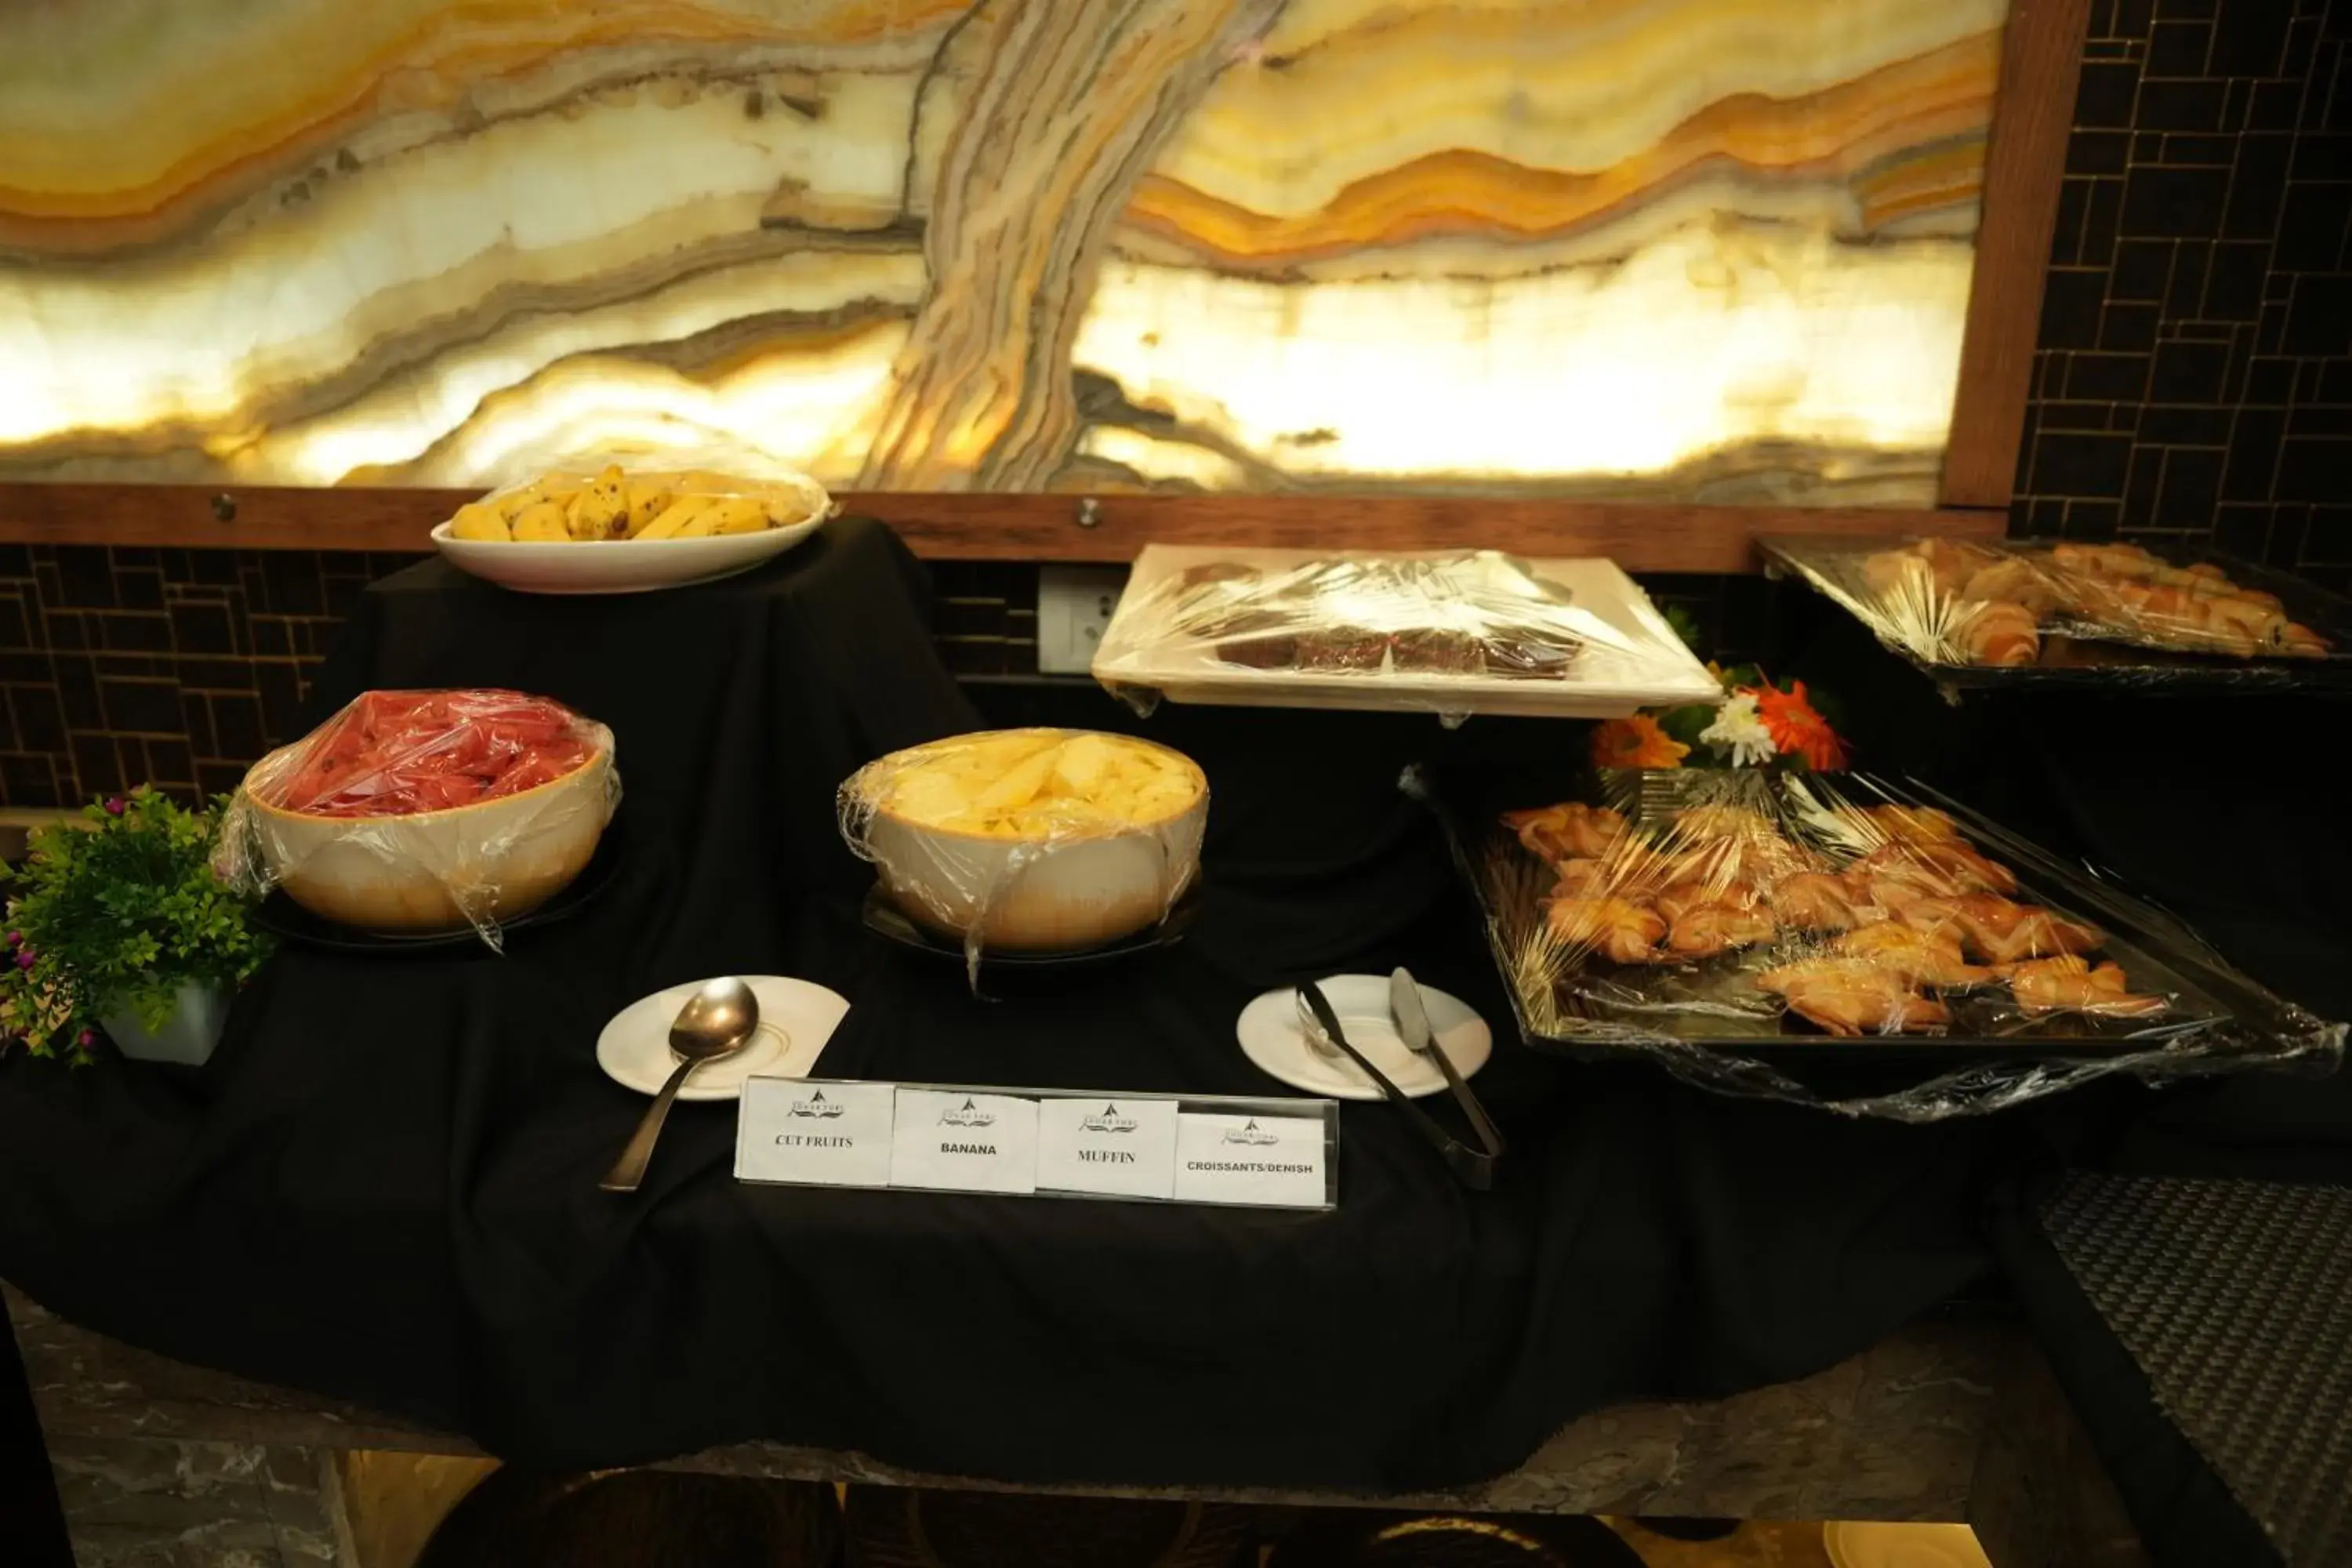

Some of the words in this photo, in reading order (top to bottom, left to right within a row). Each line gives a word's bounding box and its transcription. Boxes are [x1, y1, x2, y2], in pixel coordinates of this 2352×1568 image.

[775, 1134, 804, 1147] CUT
[805, 1135, 854, 1149] FRUITS
[940, 1142, 997, 1155] BANANA
[1077, 1149, 1136, 1163] MUFFIN
[1186, 1160, 1314, 1174] CROISSANTS/DENISH
